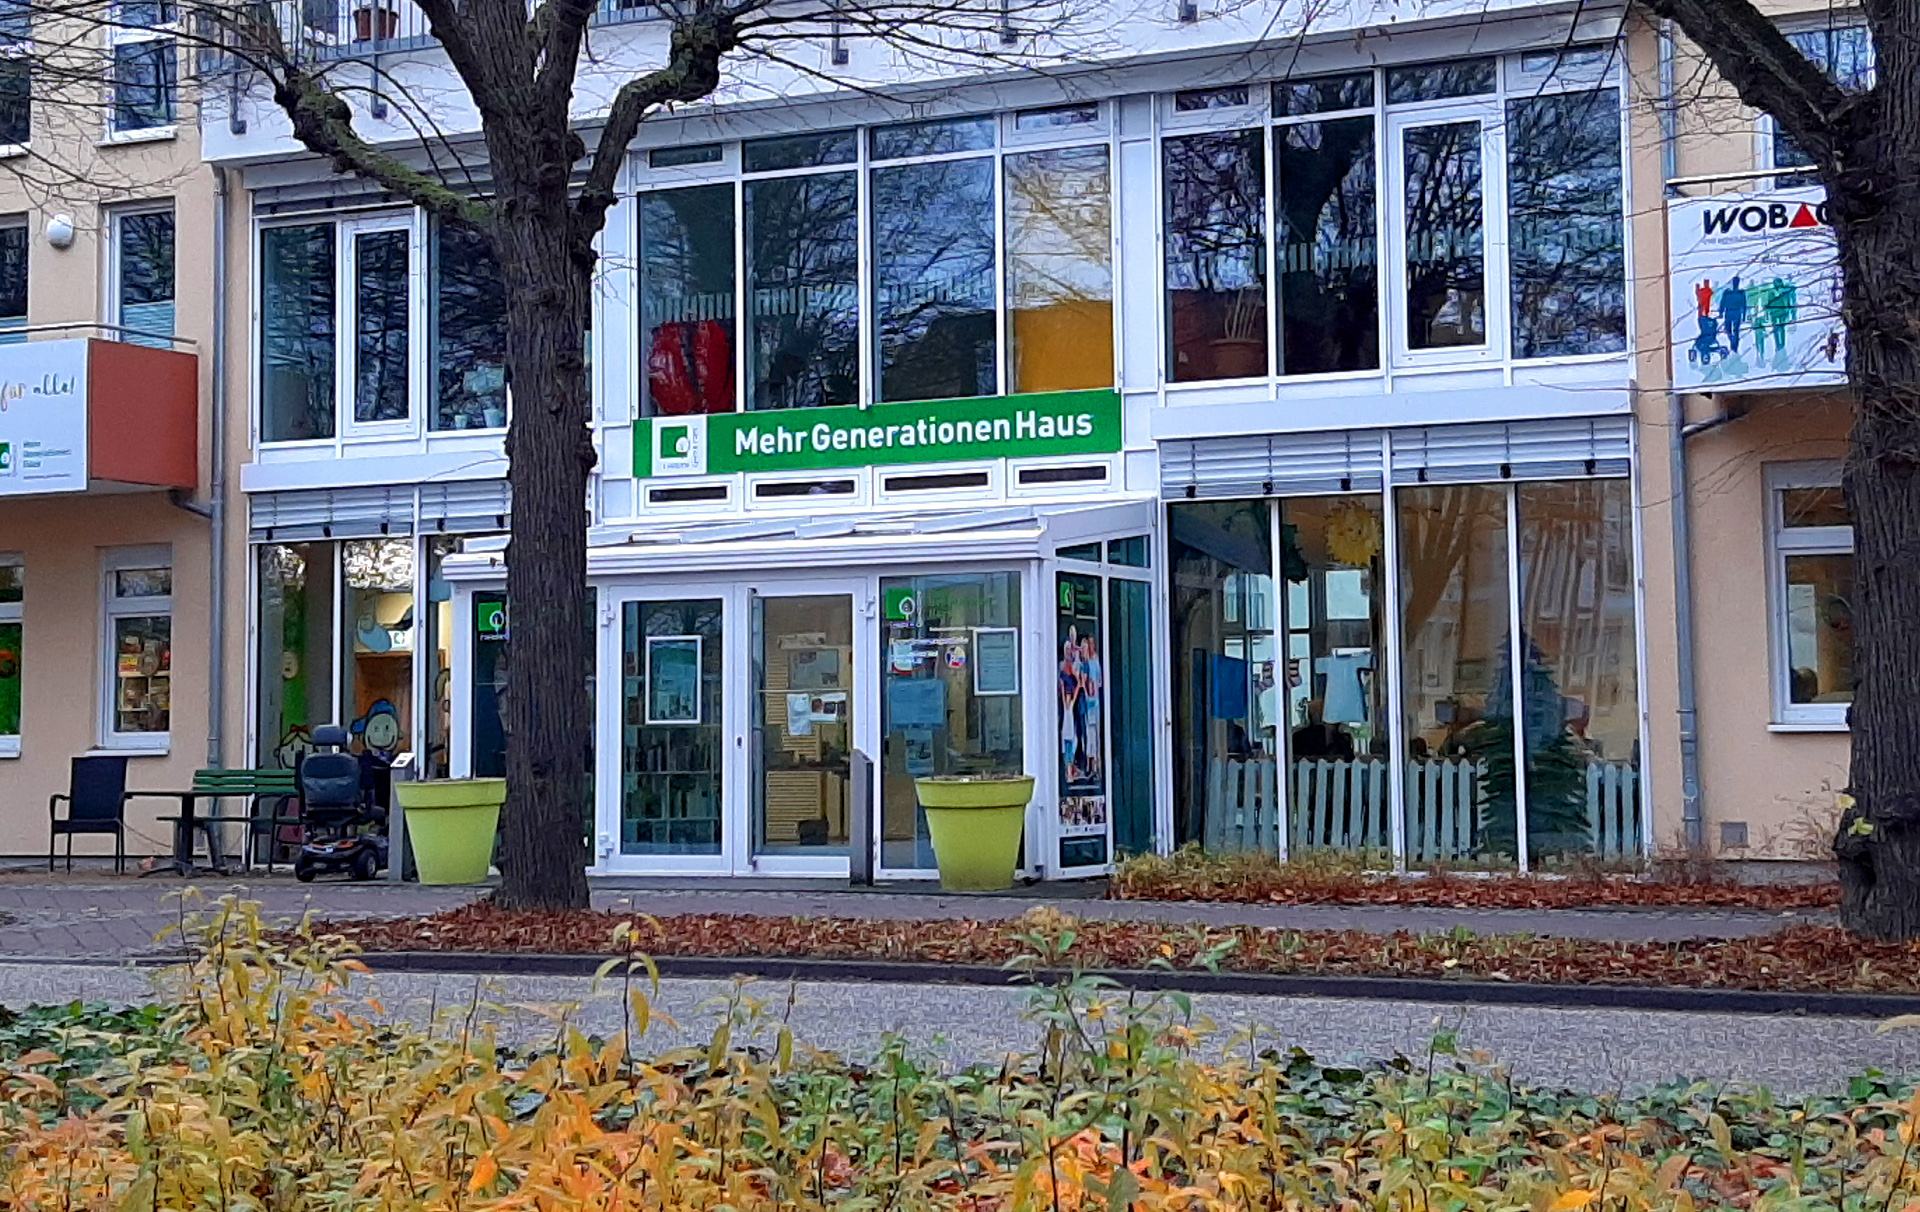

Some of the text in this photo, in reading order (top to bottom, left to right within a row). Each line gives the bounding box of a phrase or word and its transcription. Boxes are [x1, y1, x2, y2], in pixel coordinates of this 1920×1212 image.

[735, 426, 807, 456] Mehr
[811, 414, 1010, 452] Generationen
[1015, 409, 1094, 440] Haus
